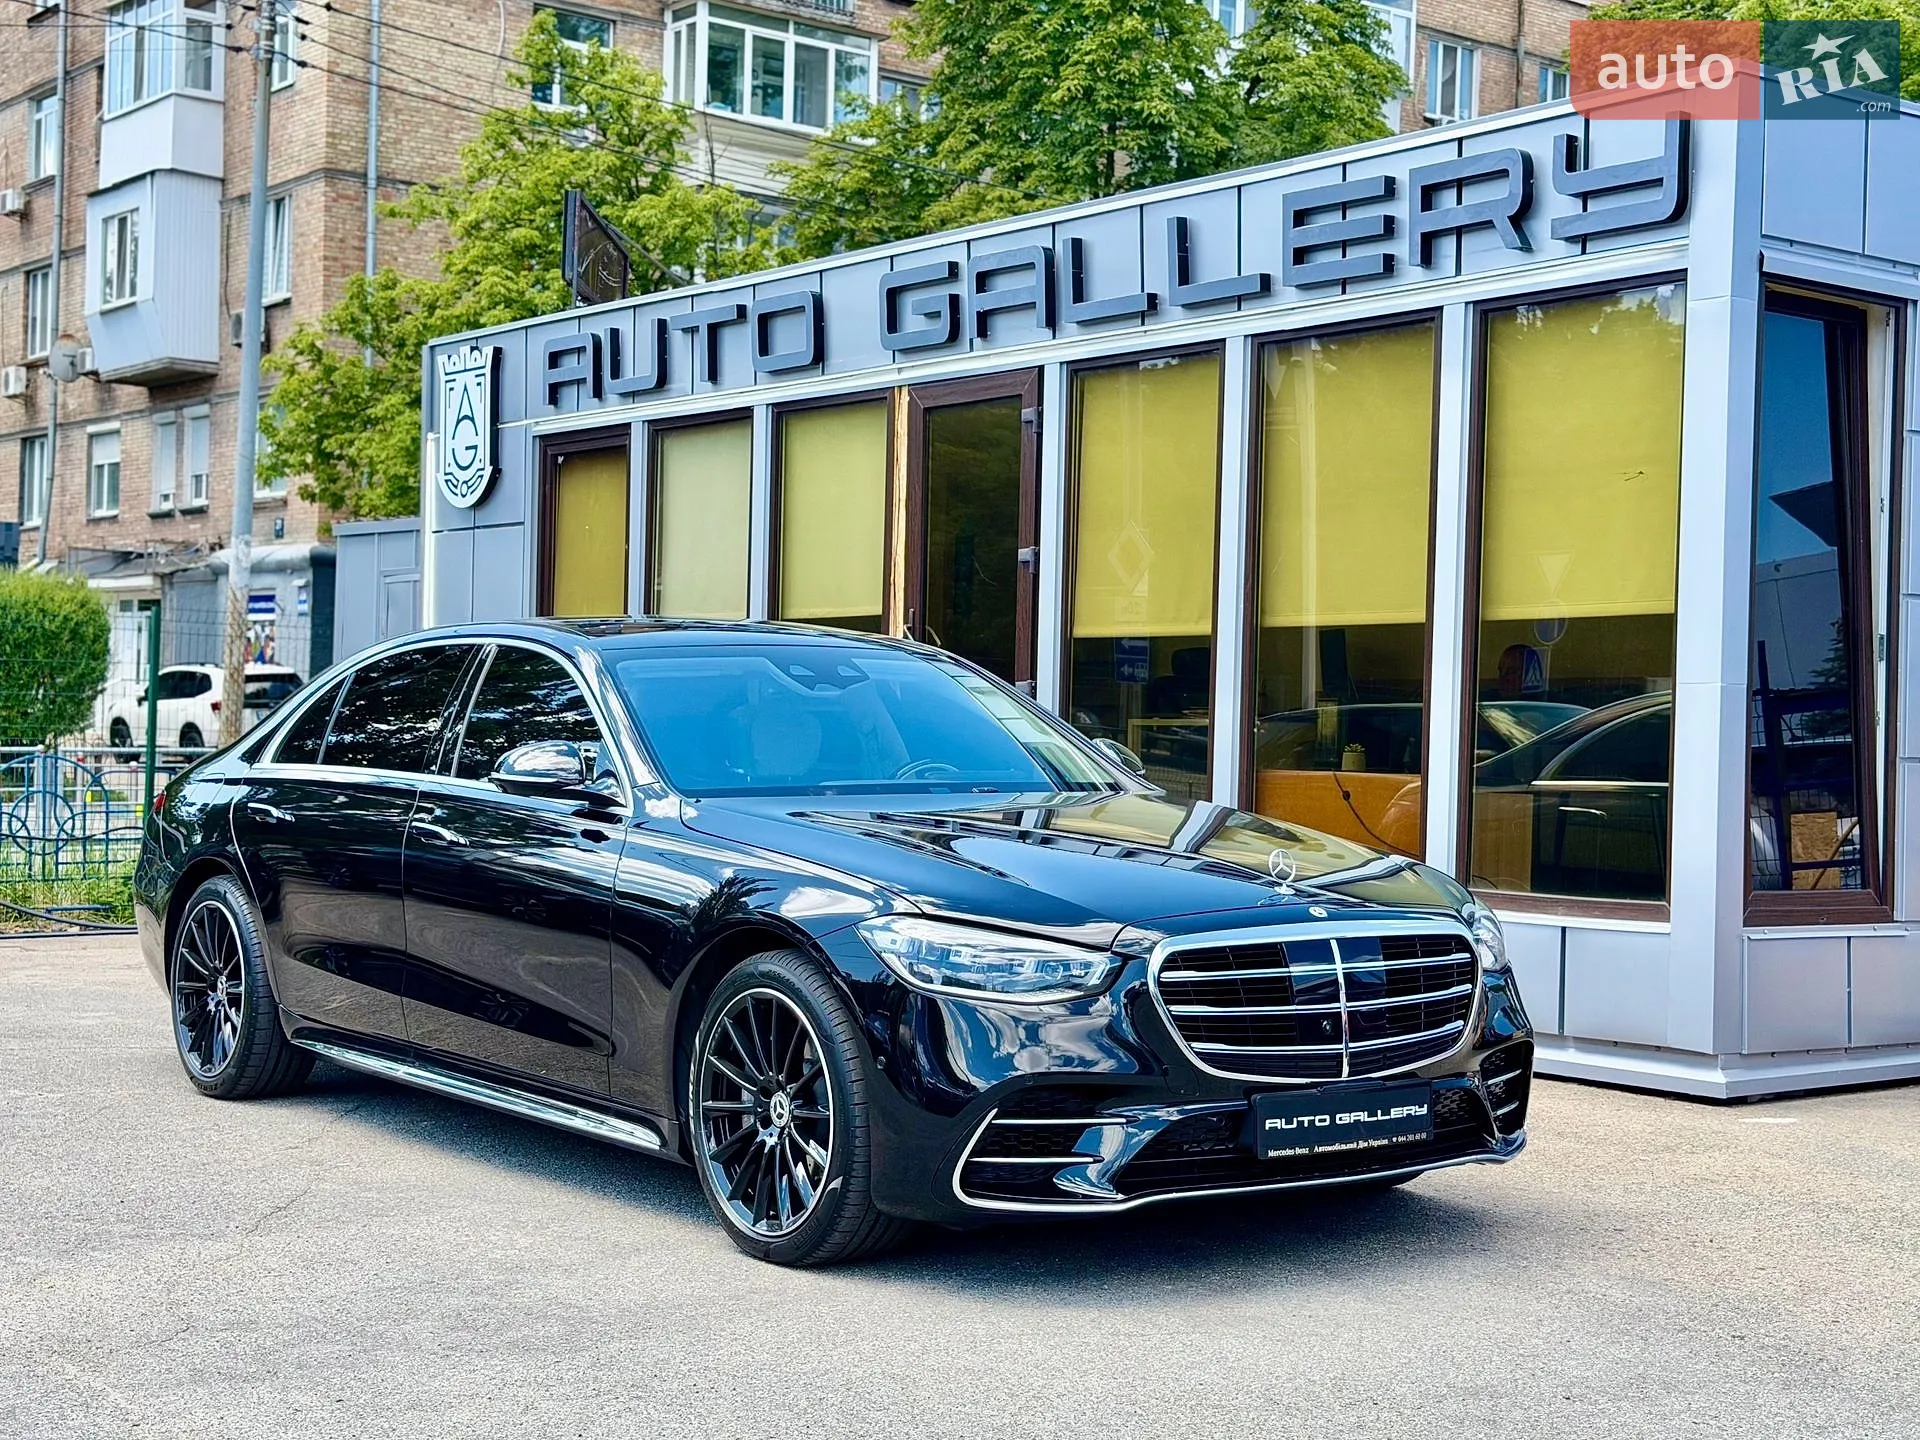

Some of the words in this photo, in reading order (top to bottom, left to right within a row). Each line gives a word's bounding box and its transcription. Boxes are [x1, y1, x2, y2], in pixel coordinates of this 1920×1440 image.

[543, 290, 824, 406] AUTO
[879, 110, 1691, 352] GALLERY
[1265, 1115, 1330, 1130] AUTO
[1335, 1104, 1428, 1125] GALLERY
